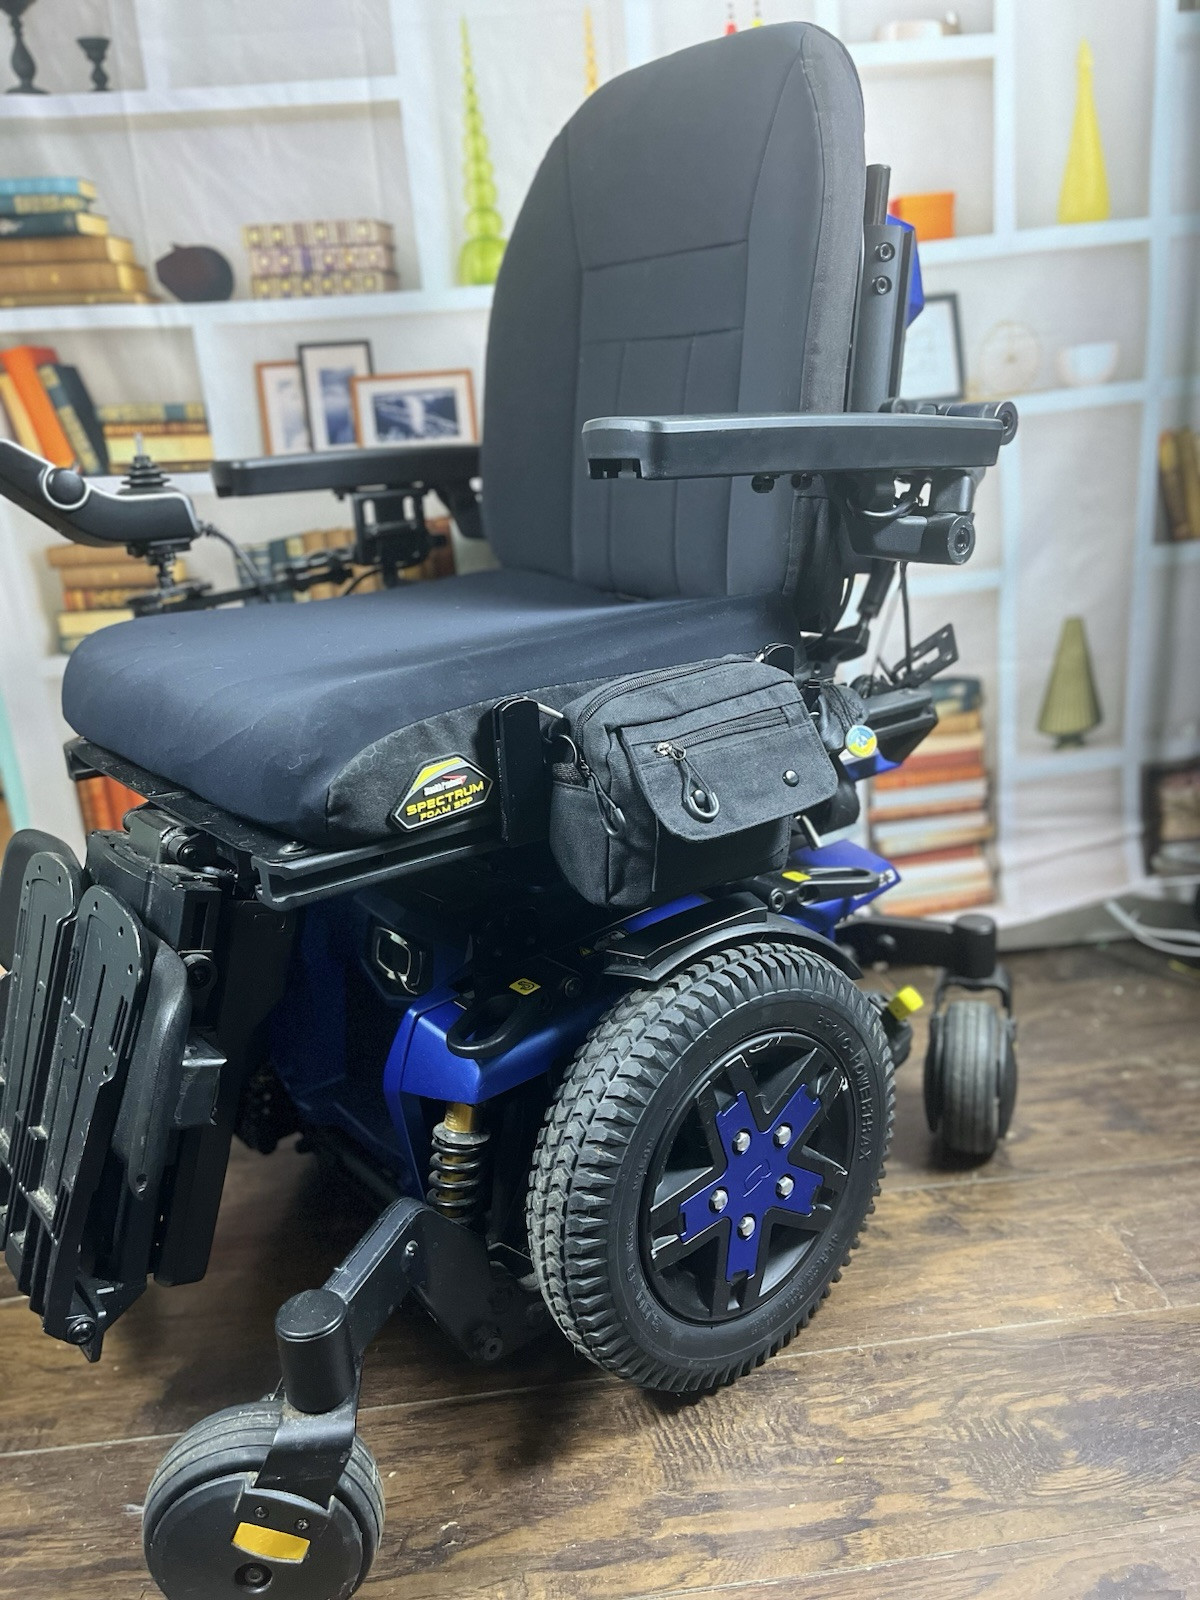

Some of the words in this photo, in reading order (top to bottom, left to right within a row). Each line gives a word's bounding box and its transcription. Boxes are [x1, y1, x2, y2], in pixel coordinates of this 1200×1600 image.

[406, 780, 485, 816] SPECTRUM
[420, 805, 452, 821] FOAM
[453, 796, 474, 809] SPP
